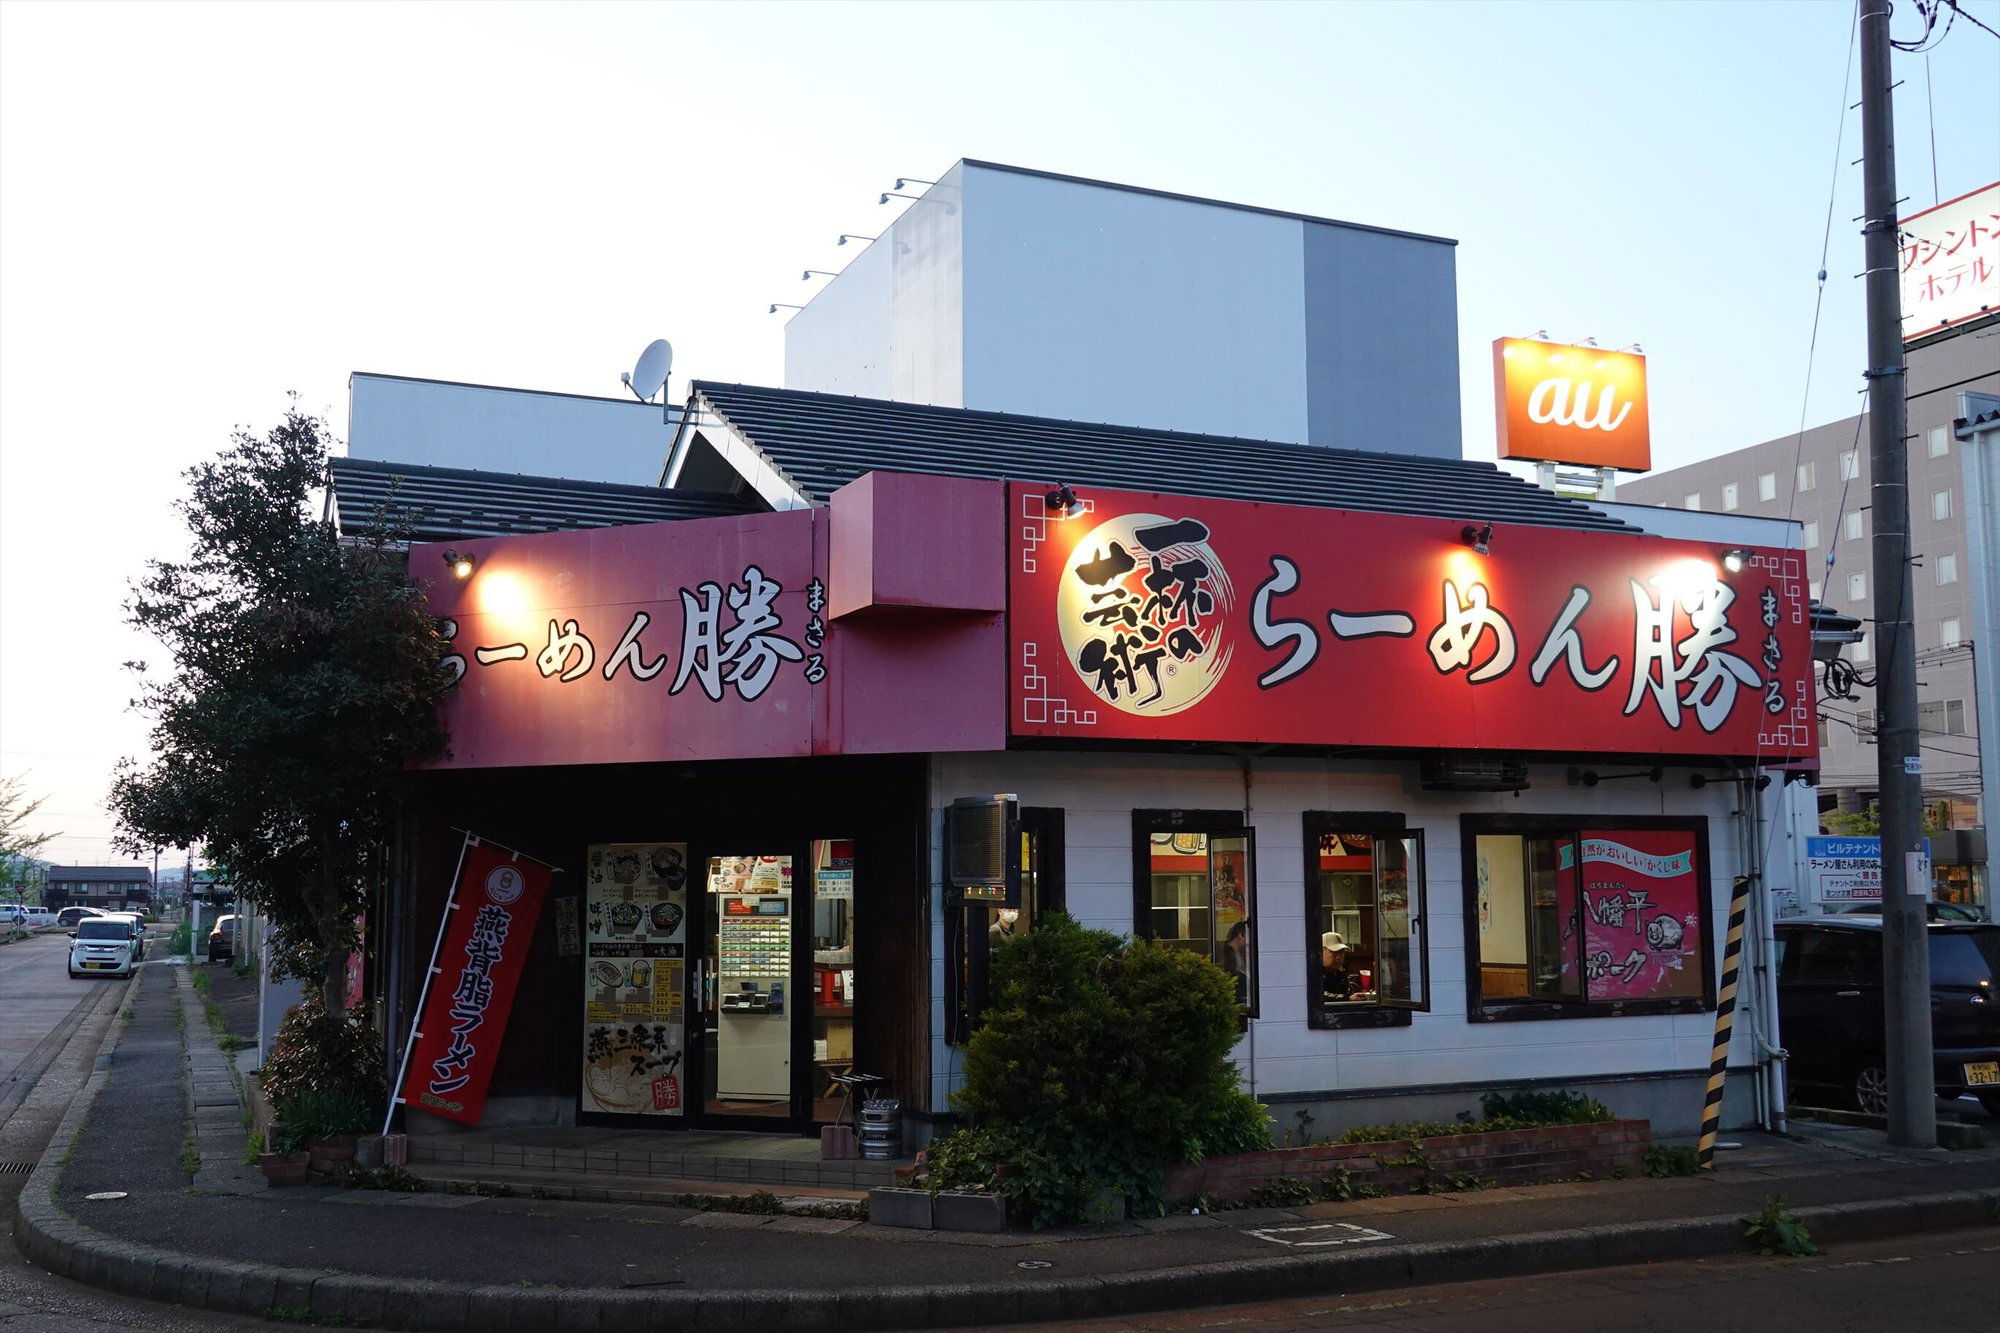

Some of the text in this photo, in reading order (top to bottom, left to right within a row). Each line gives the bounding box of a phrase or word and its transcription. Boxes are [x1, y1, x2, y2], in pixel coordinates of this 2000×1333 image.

[1919, 256, 1993, 303] ホテル
[1527, 377, 1633, 432] au
[804, 576, 827, 685] まさる
[1075, 541, 1167, 707] 芸術
[1134, 518, 1213, 661] 一杯の
[1760, 586, 1786, 715] まさる
[1827, 842, 1881, 855] ビルテナント
[430, 904, 511, 1094] 燕背脂ラーメン
[629, 1050, 682, 1077] スープ
